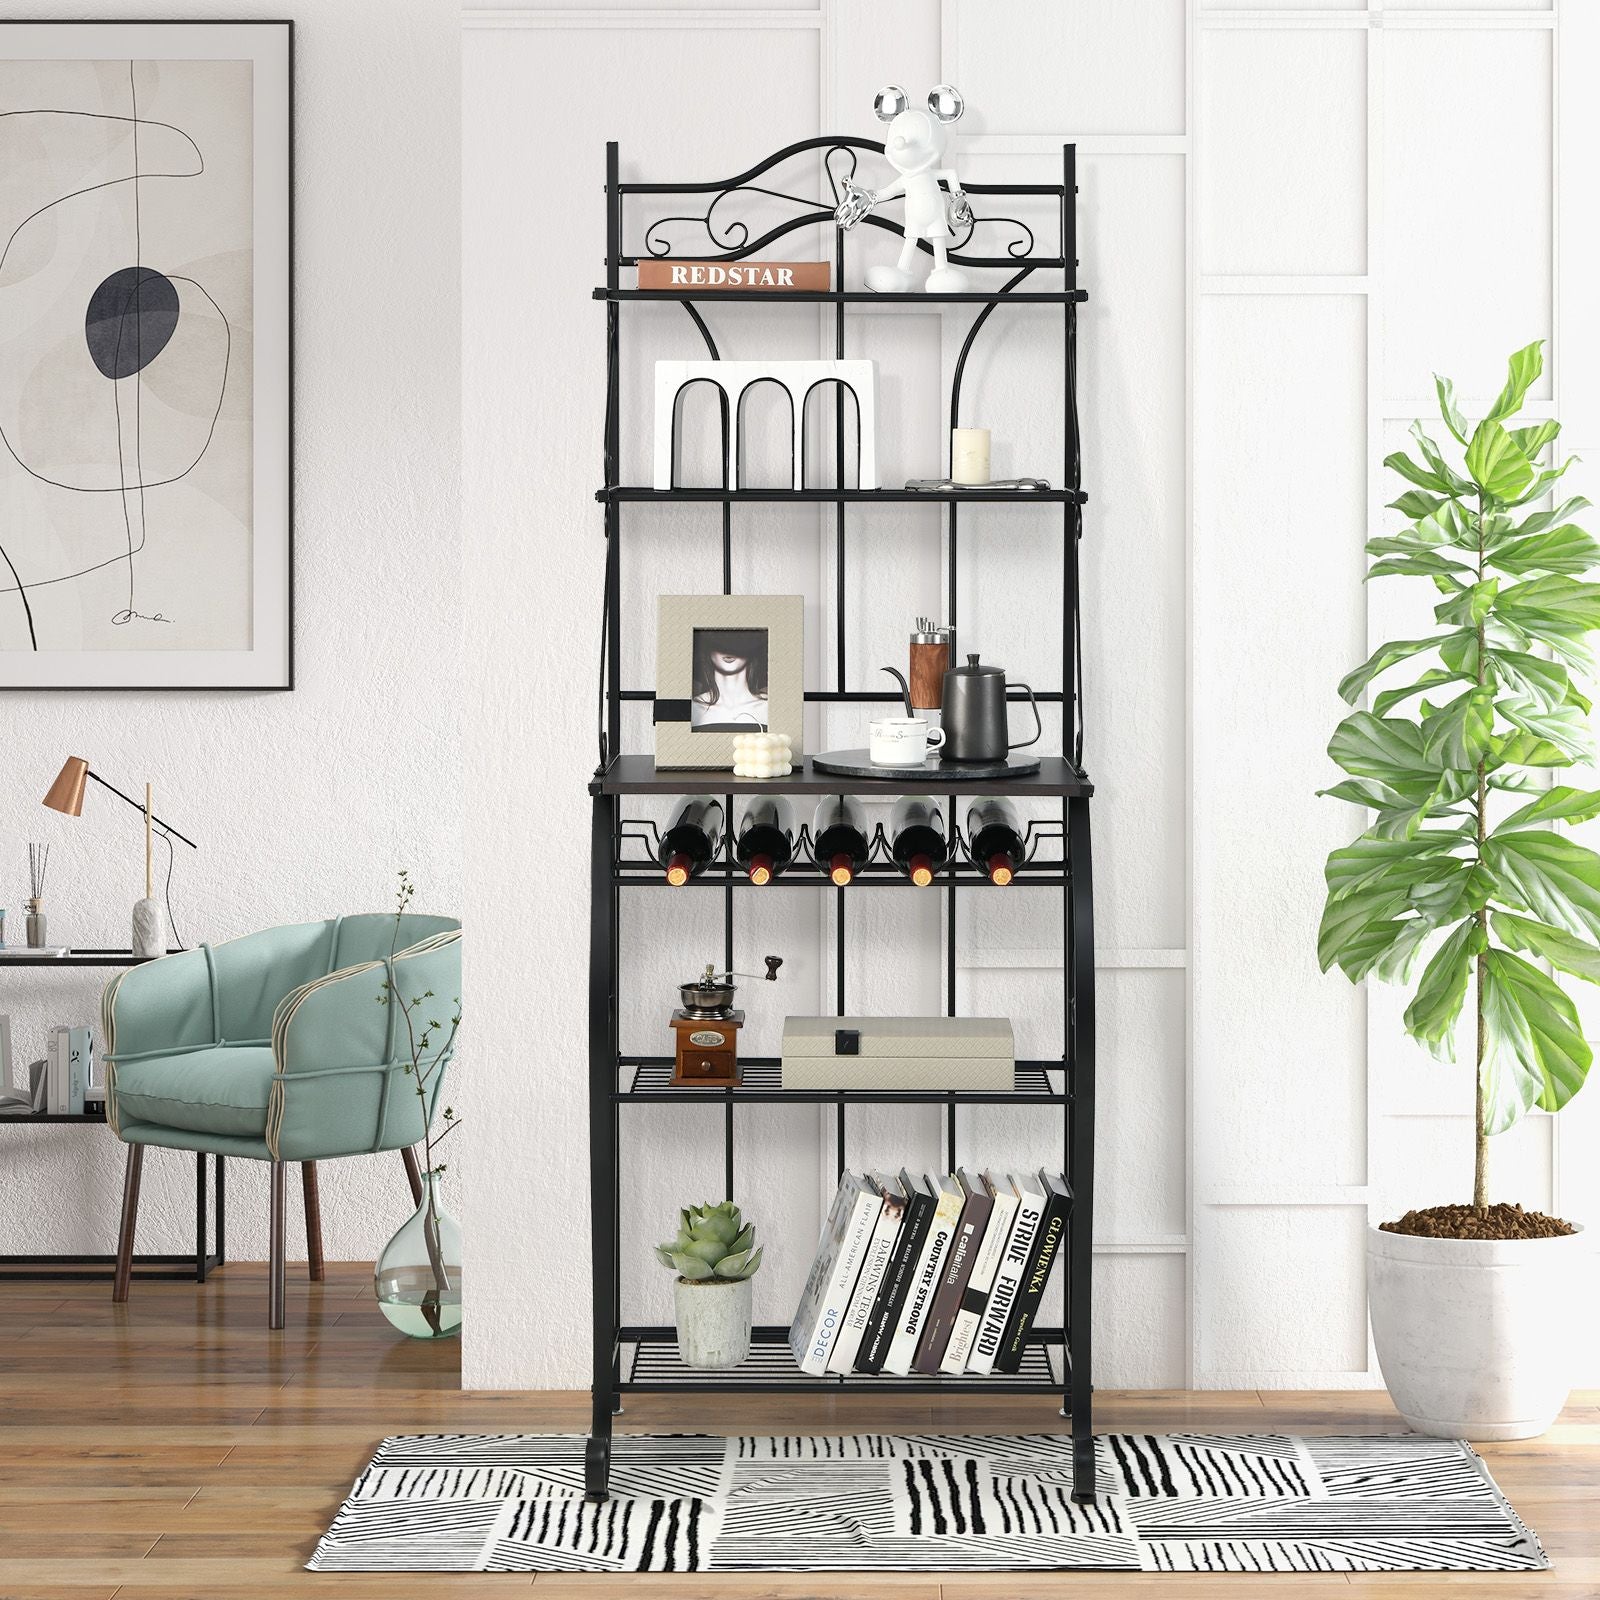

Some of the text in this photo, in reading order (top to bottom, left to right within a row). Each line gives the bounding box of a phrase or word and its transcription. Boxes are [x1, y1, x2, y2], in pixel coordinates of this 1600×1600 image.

[671, 266, 794, 286] REDSTAR
[839, 1203, 872, 1289] ALL-AMERICAN FLAIR
[945, 1234, 970, 1286] caliaitalia
[1007, 1209, 1039, 1266] STRIVE
[853, 1239, 891, 1330] DARWINS TEORI
[904, 1231, 948, 1336] COUNTRY STRONG
[813, 1309, 838, 1357] DECOR
[949, 1320, 973, 1362] Brightest
[977, 1275, 1017, 1356] FORWARD
[866, 1333, 882, 1364] ANDREW
